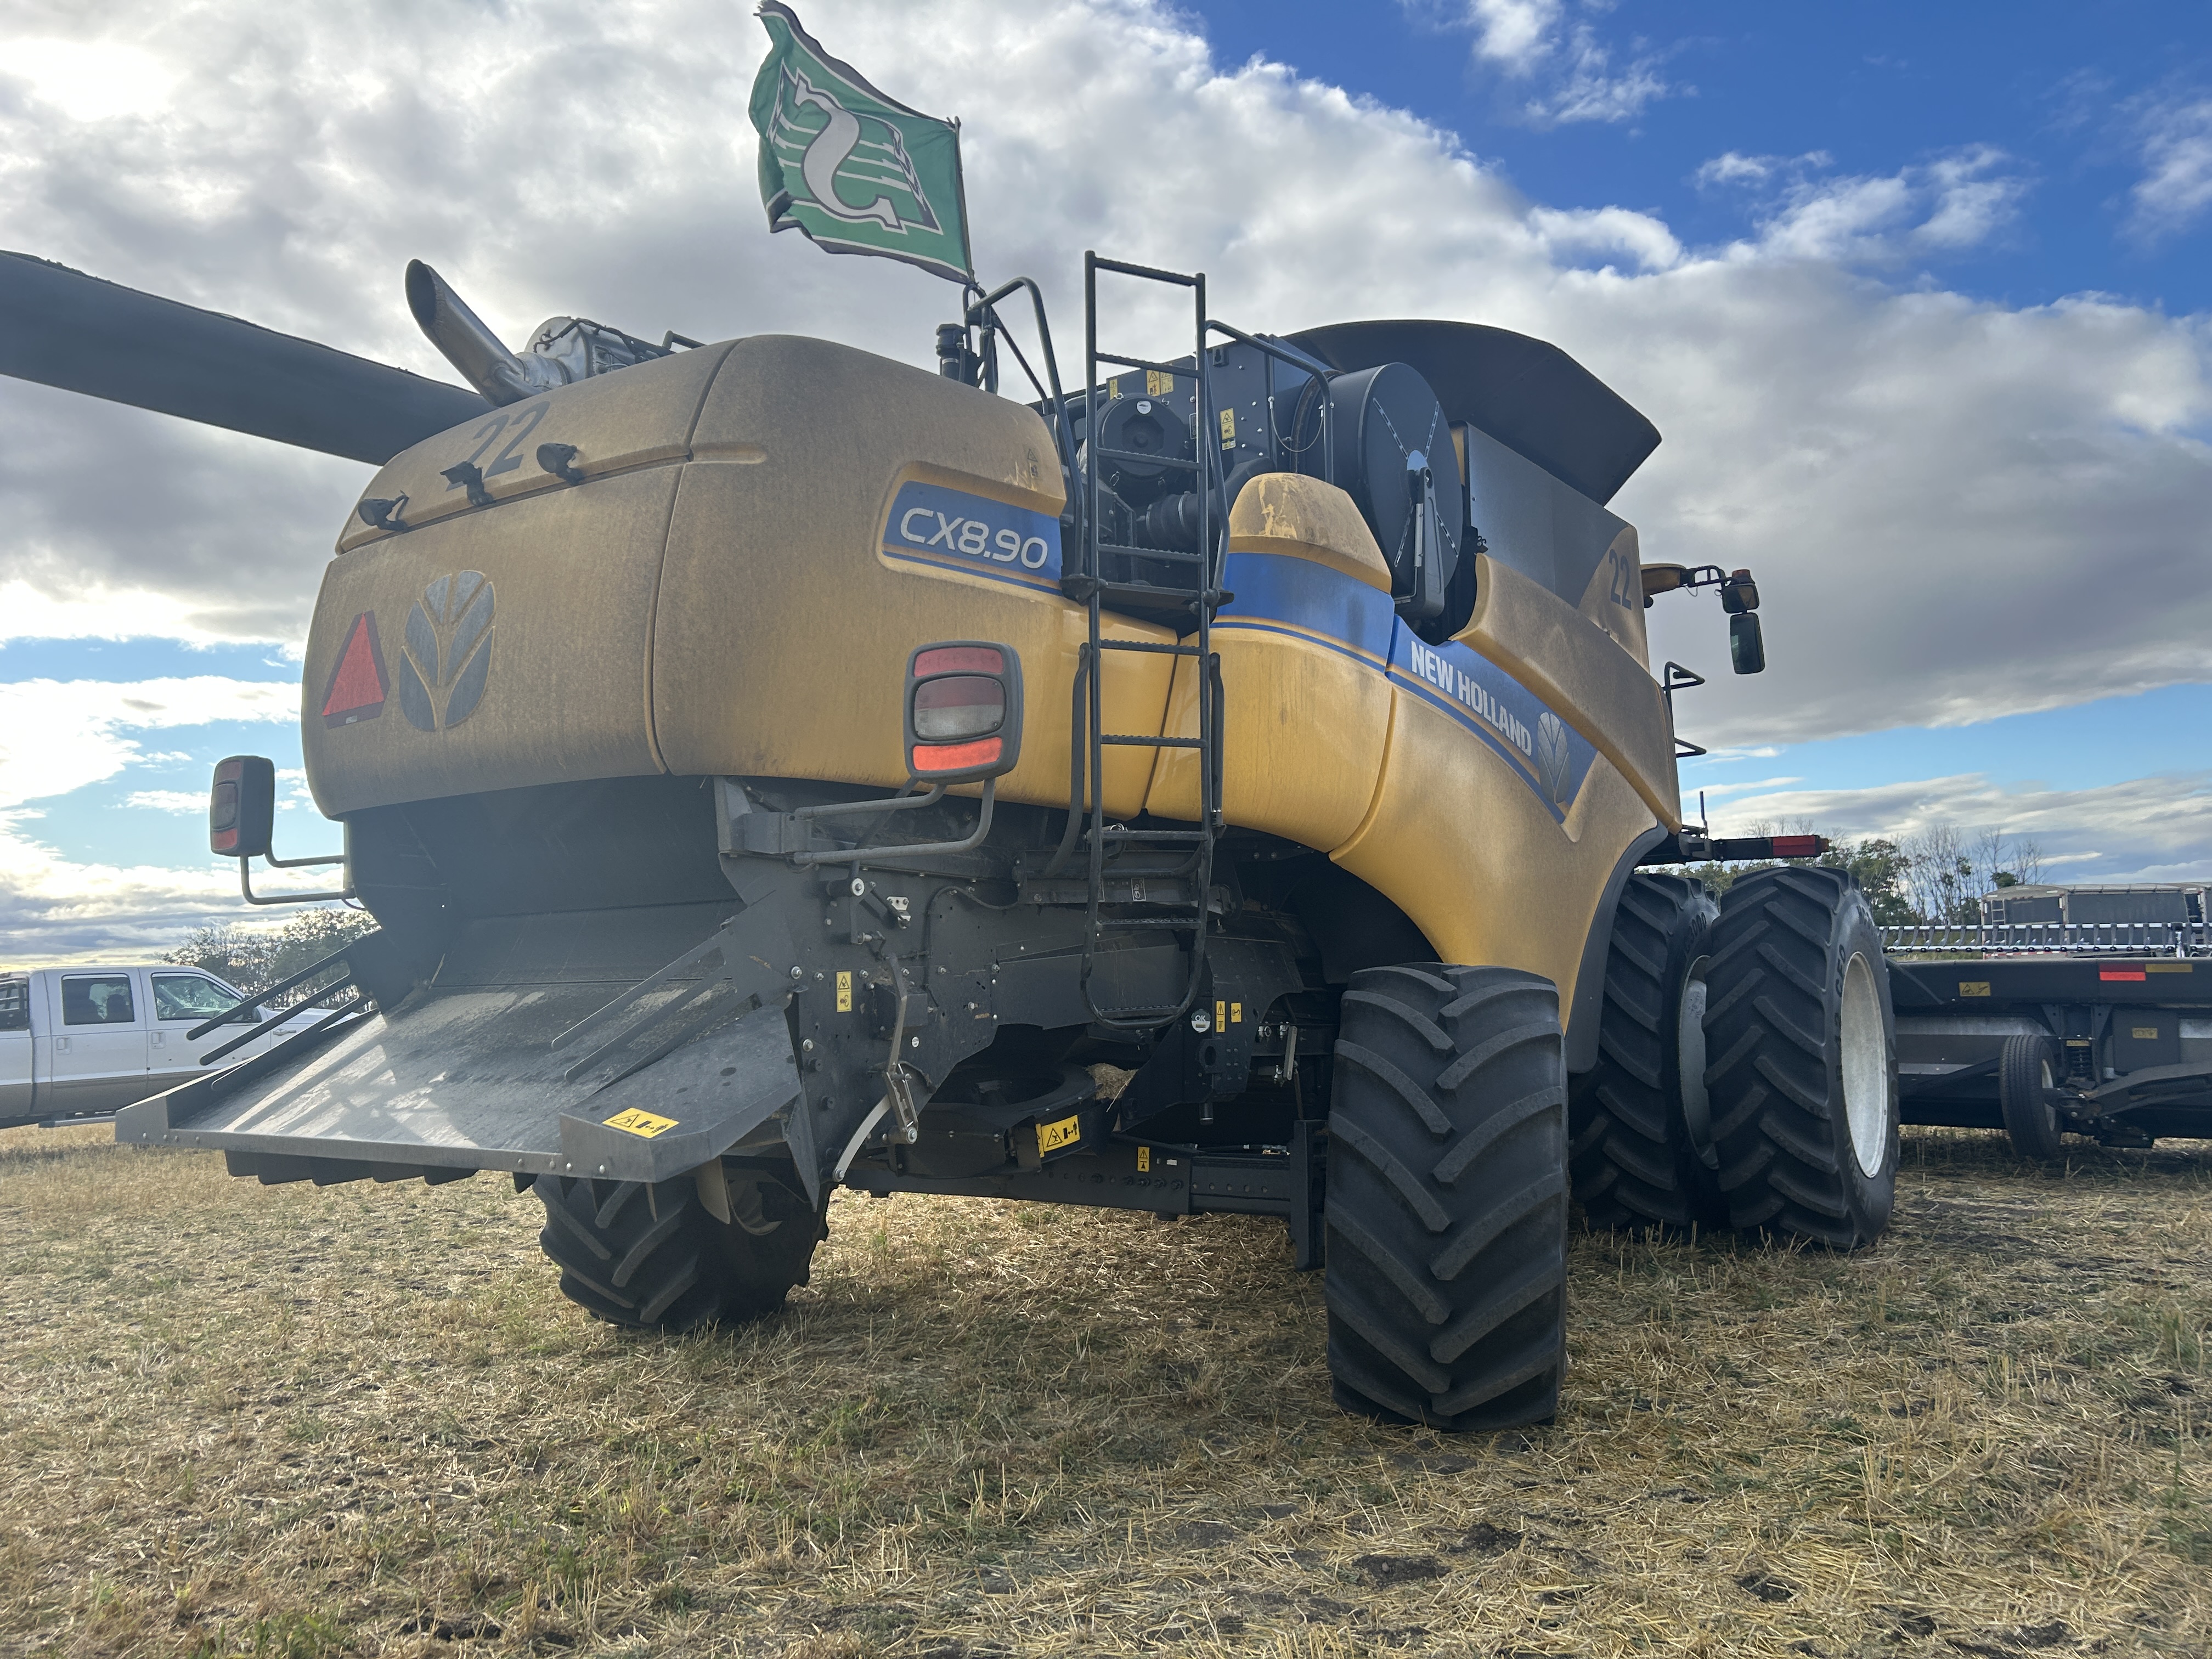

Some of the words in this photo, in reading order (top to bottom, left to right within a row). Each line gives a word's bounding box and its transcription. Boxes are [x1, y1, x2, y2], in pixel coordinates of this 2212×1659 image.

[445, 401, 550, 492] 22
[900, 507, 1048, 569] CX8.90
[1609, 549, 1632, 610] 22
[1411, 640, 1454, 695] NEW
[1457, 670, 1532, 757] HOLLAND
